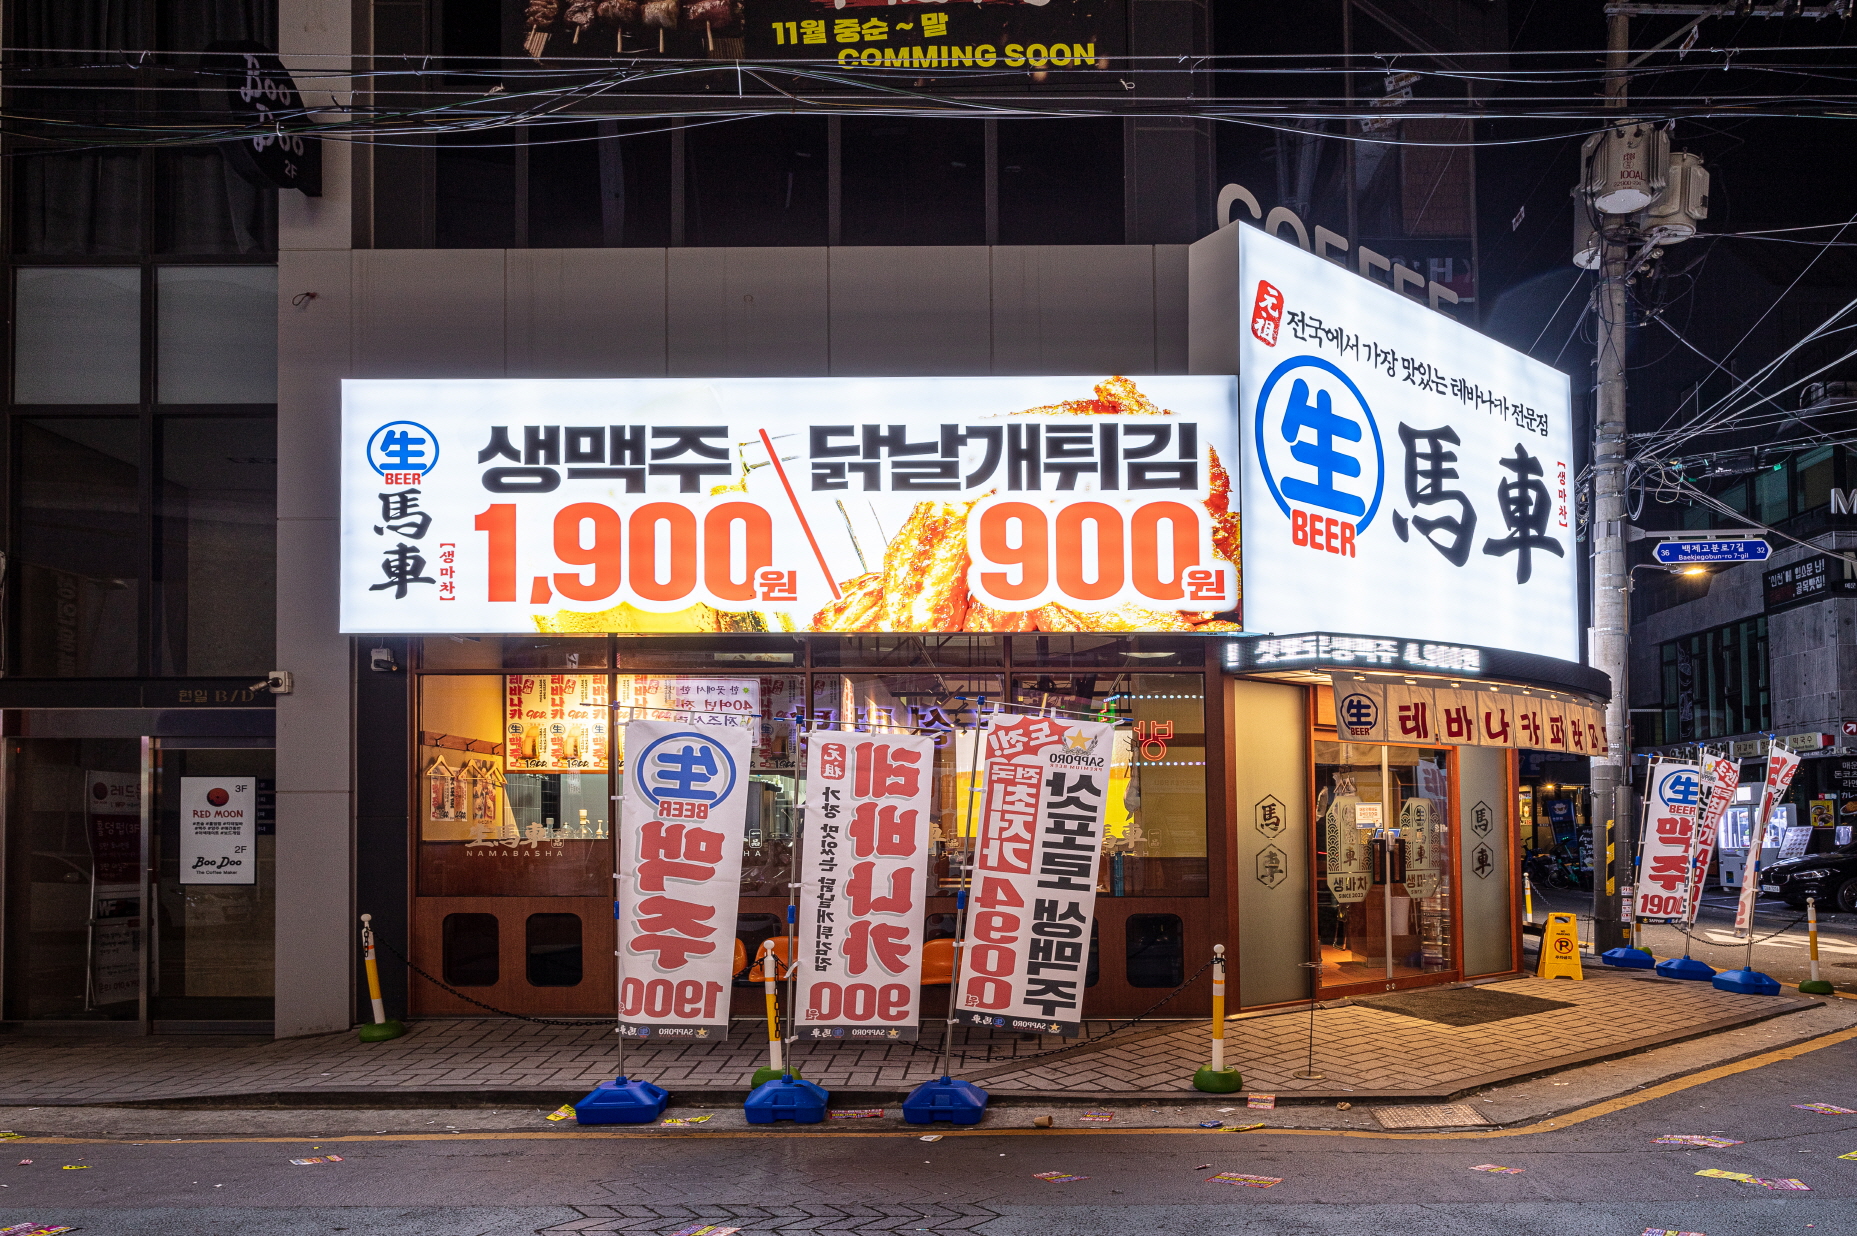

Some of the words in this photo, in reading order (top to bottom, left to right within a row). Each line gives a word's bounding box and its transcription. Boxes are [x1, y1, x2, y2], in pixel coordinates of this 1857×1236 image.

[772, 19, 827, 45] 11월
[833, 17, 889, 44] 중순
[920, 12, 949, 38] 말
[838, 44, 997, 69] COMMING
[1004, 43, 1095, 68] SOON
[1287, 310, 1360, 361] 전국에서
[1363, 341, 1398, 378] 가장
[1401, 355, 1448, 396] 맛있는
[1511, 403, 1549, 437] 전문점
[379, 430, 428, 470] 生
[809, 422, 1198, 491] 닭날개튀김
[1280, 378, 1365, 517] 生
[477, 424, 732, 494] 생맥주
[384, 473, 422, 485] BEER
[1292, 509, 1357, 558] BEER
[1678, 553, 1732, 561] Baekjegobun-ro
[1682, 543, 1745, 553] 백제고분로7길
[1346, 699, 1373, 727] 生
[1350, 728, 1370, 736] BEER
[235, 784, 247, 792] 3F
[193, 810, 211, 818] RED
[214, 810, 243, 818] MOON
[1669, 804, 1696, 815] BEER
[192, 857, 216, 869] Boo
[216, 857, 242, 869] Doo
[1334, 876, 1368, 892] 생마차
